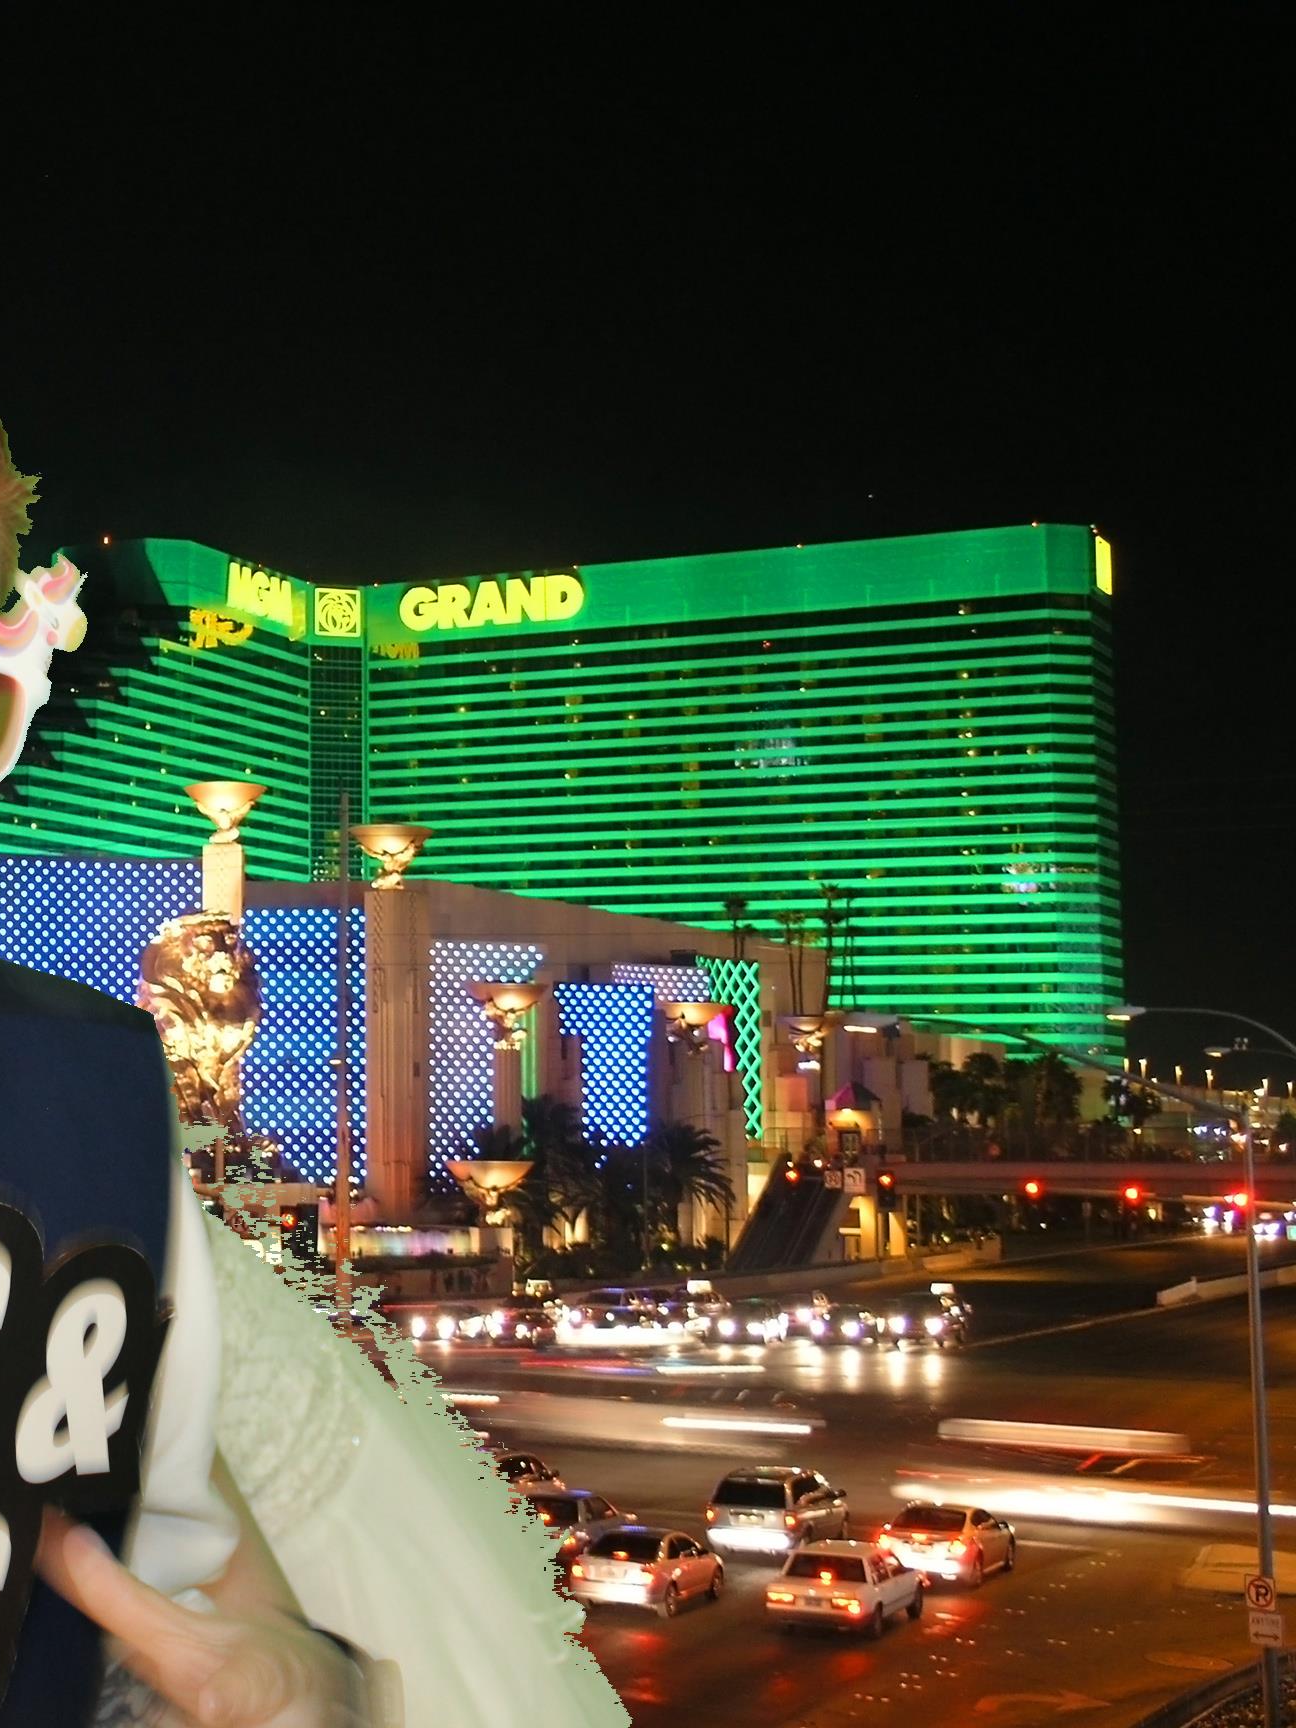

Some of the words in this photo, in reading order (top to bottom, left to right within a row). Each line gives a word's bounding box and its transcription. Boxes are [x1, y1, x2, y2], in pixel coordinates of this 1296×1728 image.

[227, 562, 293, 626] MGM
[399, 575, 584, 632] GRAND
[15, 1278, 130, 1485] &
